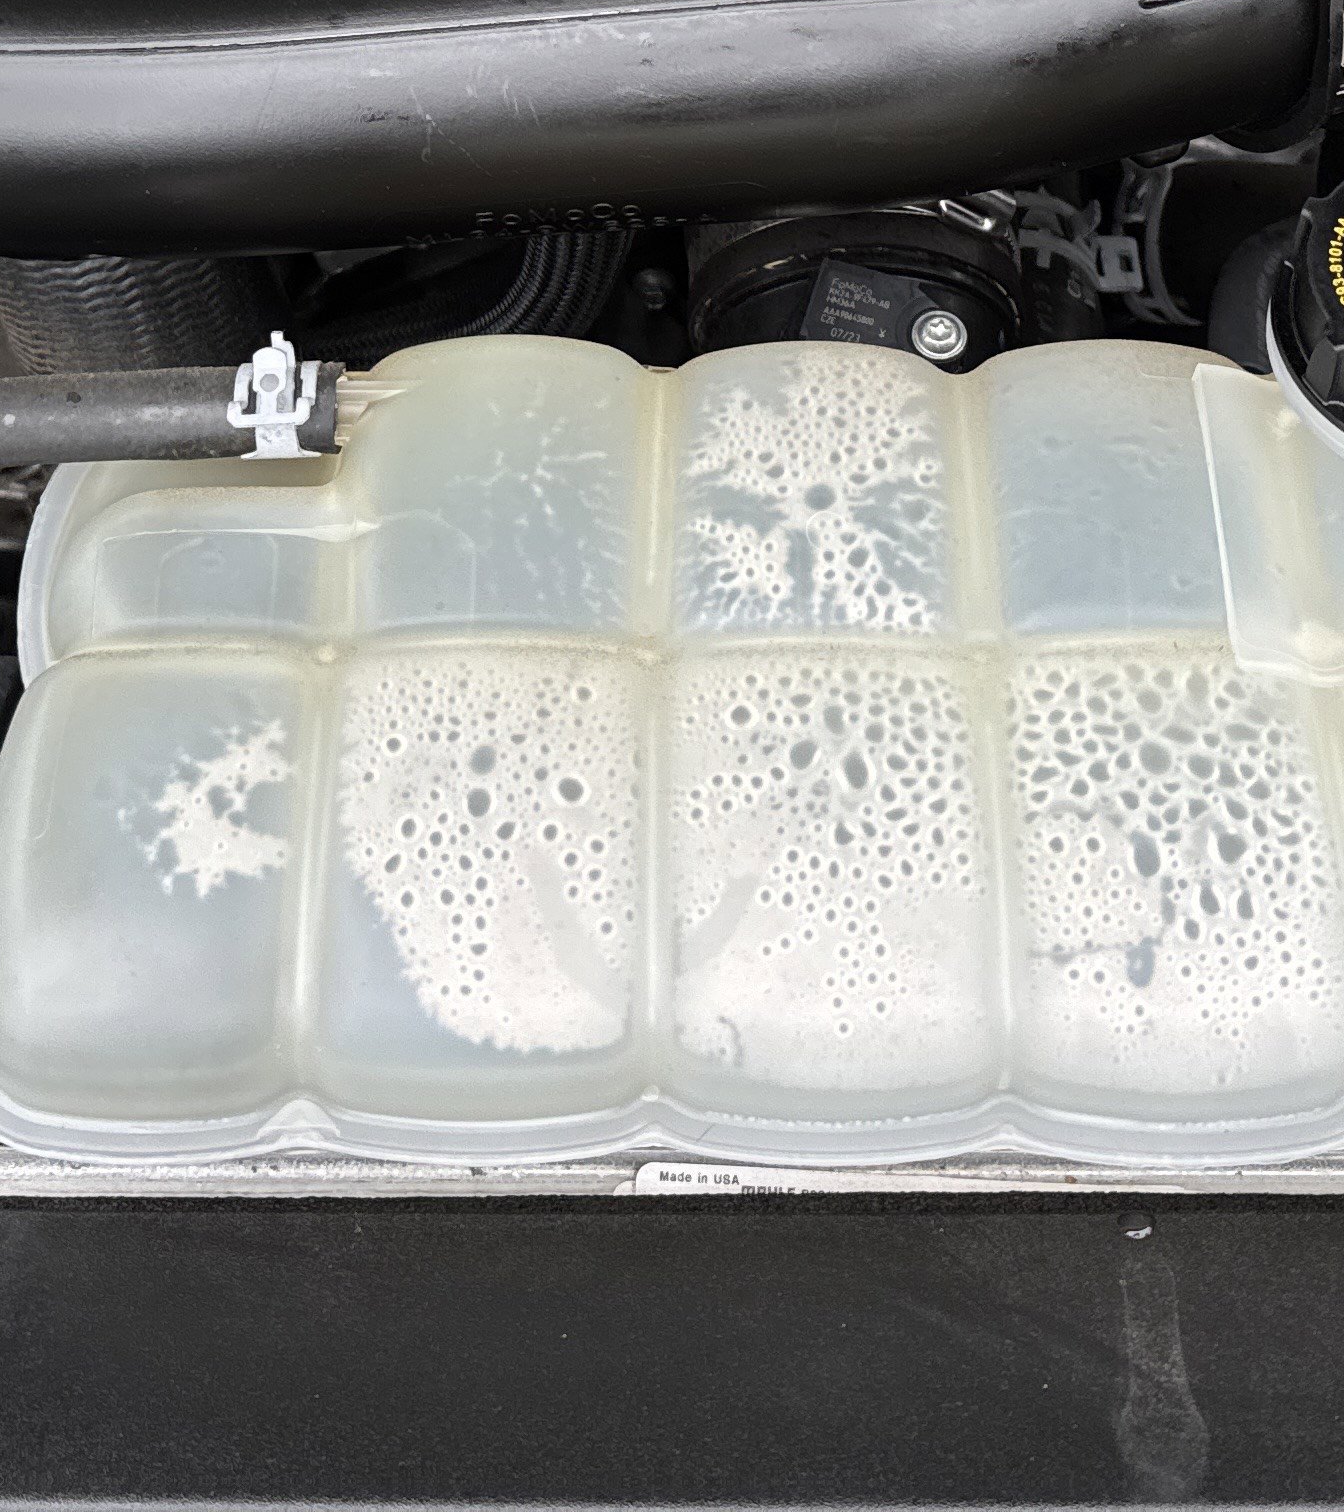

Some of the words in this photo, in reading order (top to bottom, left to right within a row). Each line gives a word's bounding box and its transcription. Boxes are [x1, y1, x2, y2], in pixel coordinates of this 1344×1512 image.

[659, 1170, 692, 1183] Made
[697, 1172, 708, 1184] in
[713, 1174, 740, 1186] USA
